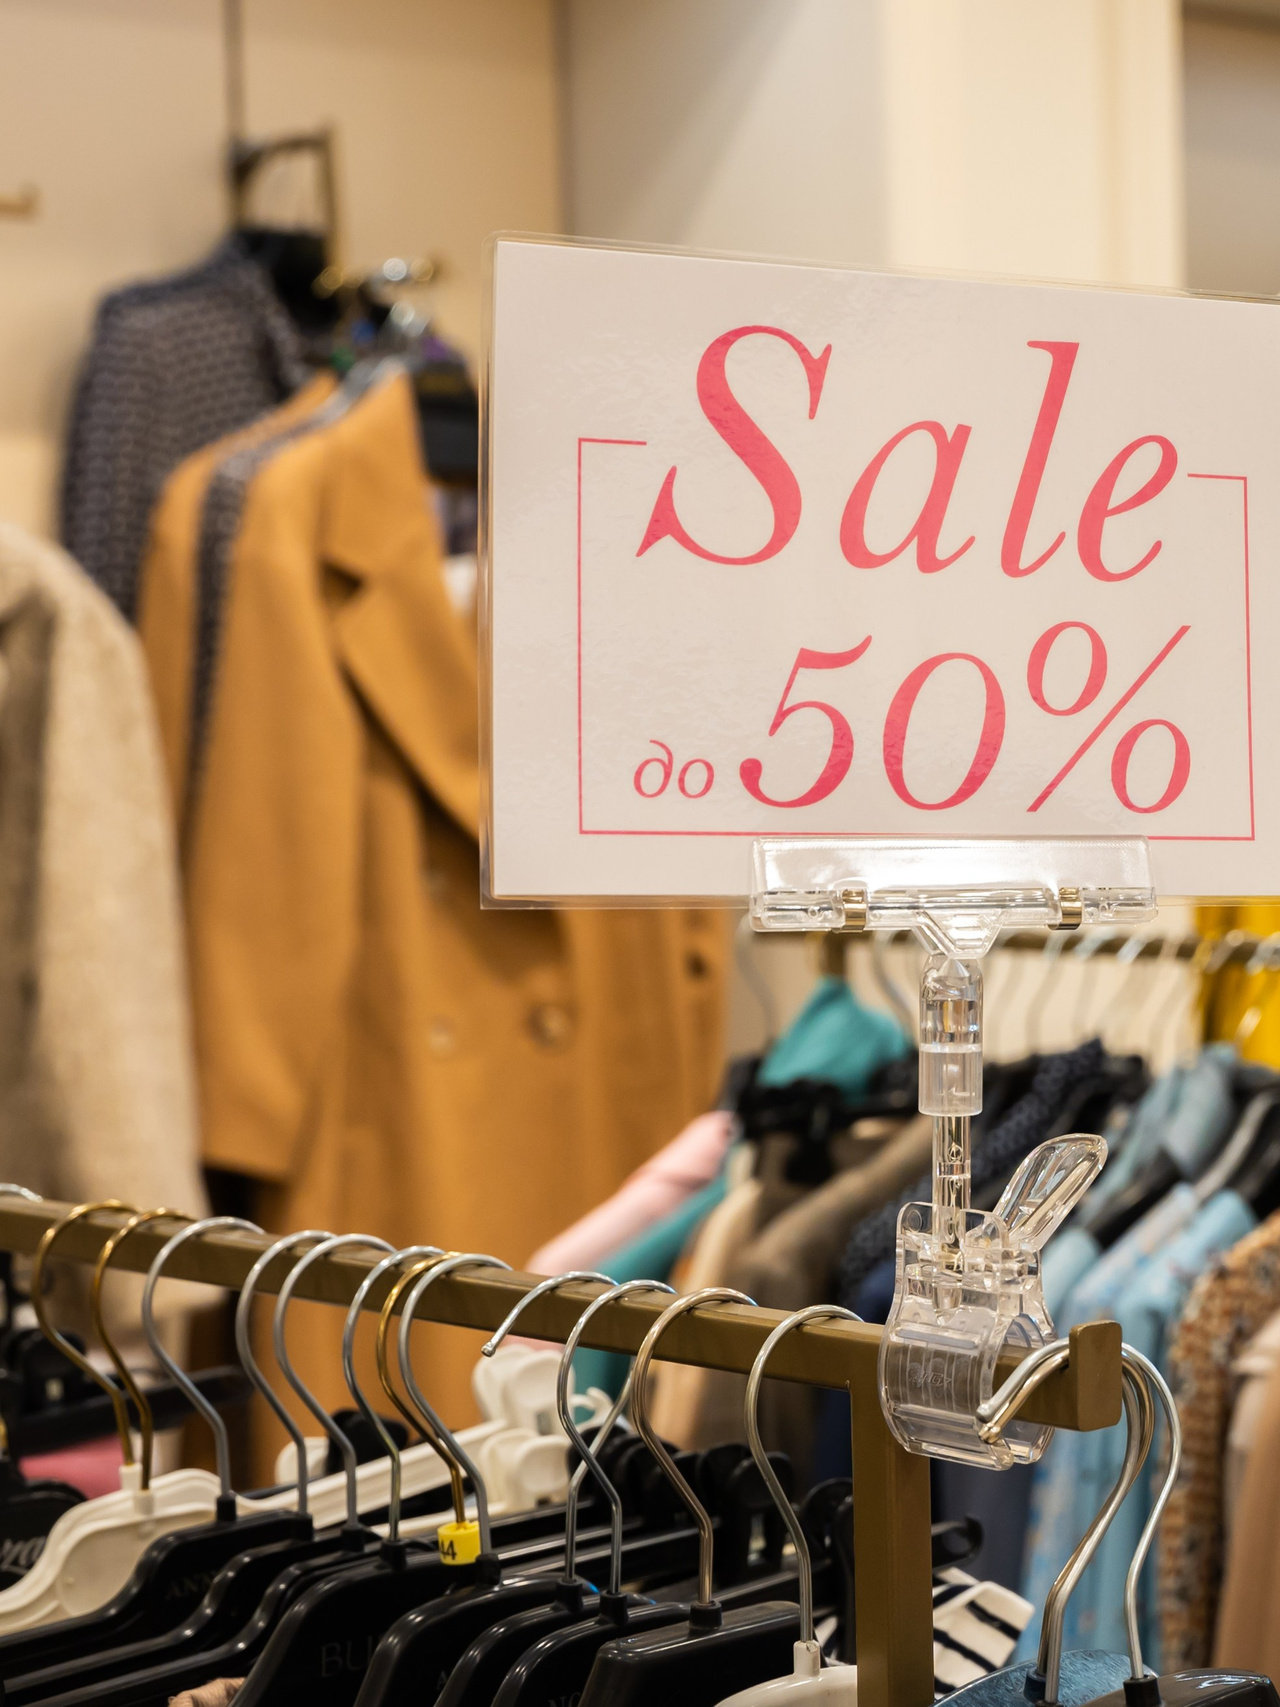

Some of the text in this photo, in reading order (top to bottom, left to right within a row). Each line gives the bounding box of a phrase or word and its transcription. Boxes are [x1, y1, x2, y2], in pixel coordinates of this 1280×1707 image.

[635, 324, 1179, 583] Sale
[632, 620, 1192, 815] до 50%
[320, 1634, 384, 1678] BU
